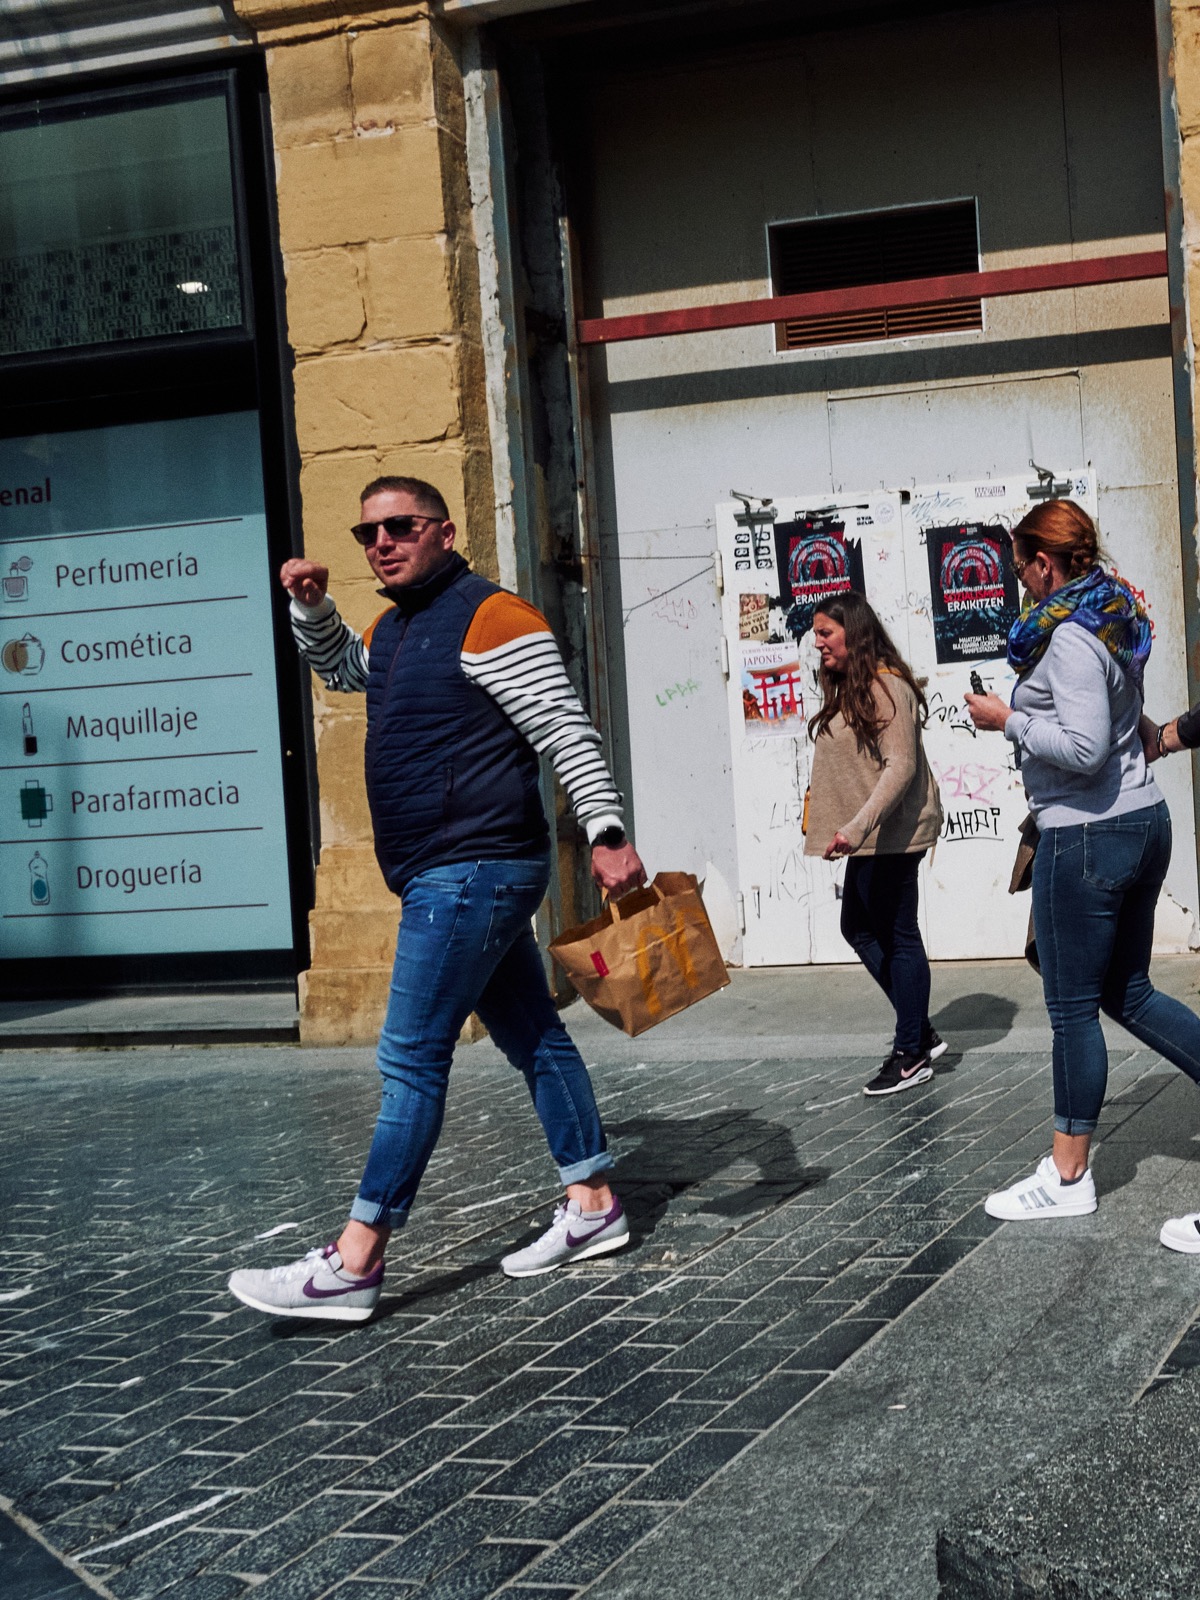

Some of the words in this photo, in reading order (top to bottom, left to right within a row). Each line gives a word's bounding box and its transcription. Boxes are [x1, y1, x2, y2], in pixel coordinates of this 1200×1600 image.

[55, 551, 199, 588] Perfumería
[791, 581, 851, 596] SOZIALISMOA
[795, 588, 850, 605] ERAIKIT
[944, 588, 1005, 603] SOZIALISMOA
[947, 596, 1004, 612] ERAIKITZEN
[60, 631, 193, 664] Cosmética
[743, 652, 783, 667] JAPONÉS
[65, 706, 199, 743] Maquillaje
[70, 780, 241, 814] Parafarmacia
[76, 858, 203, 893] Droguería
